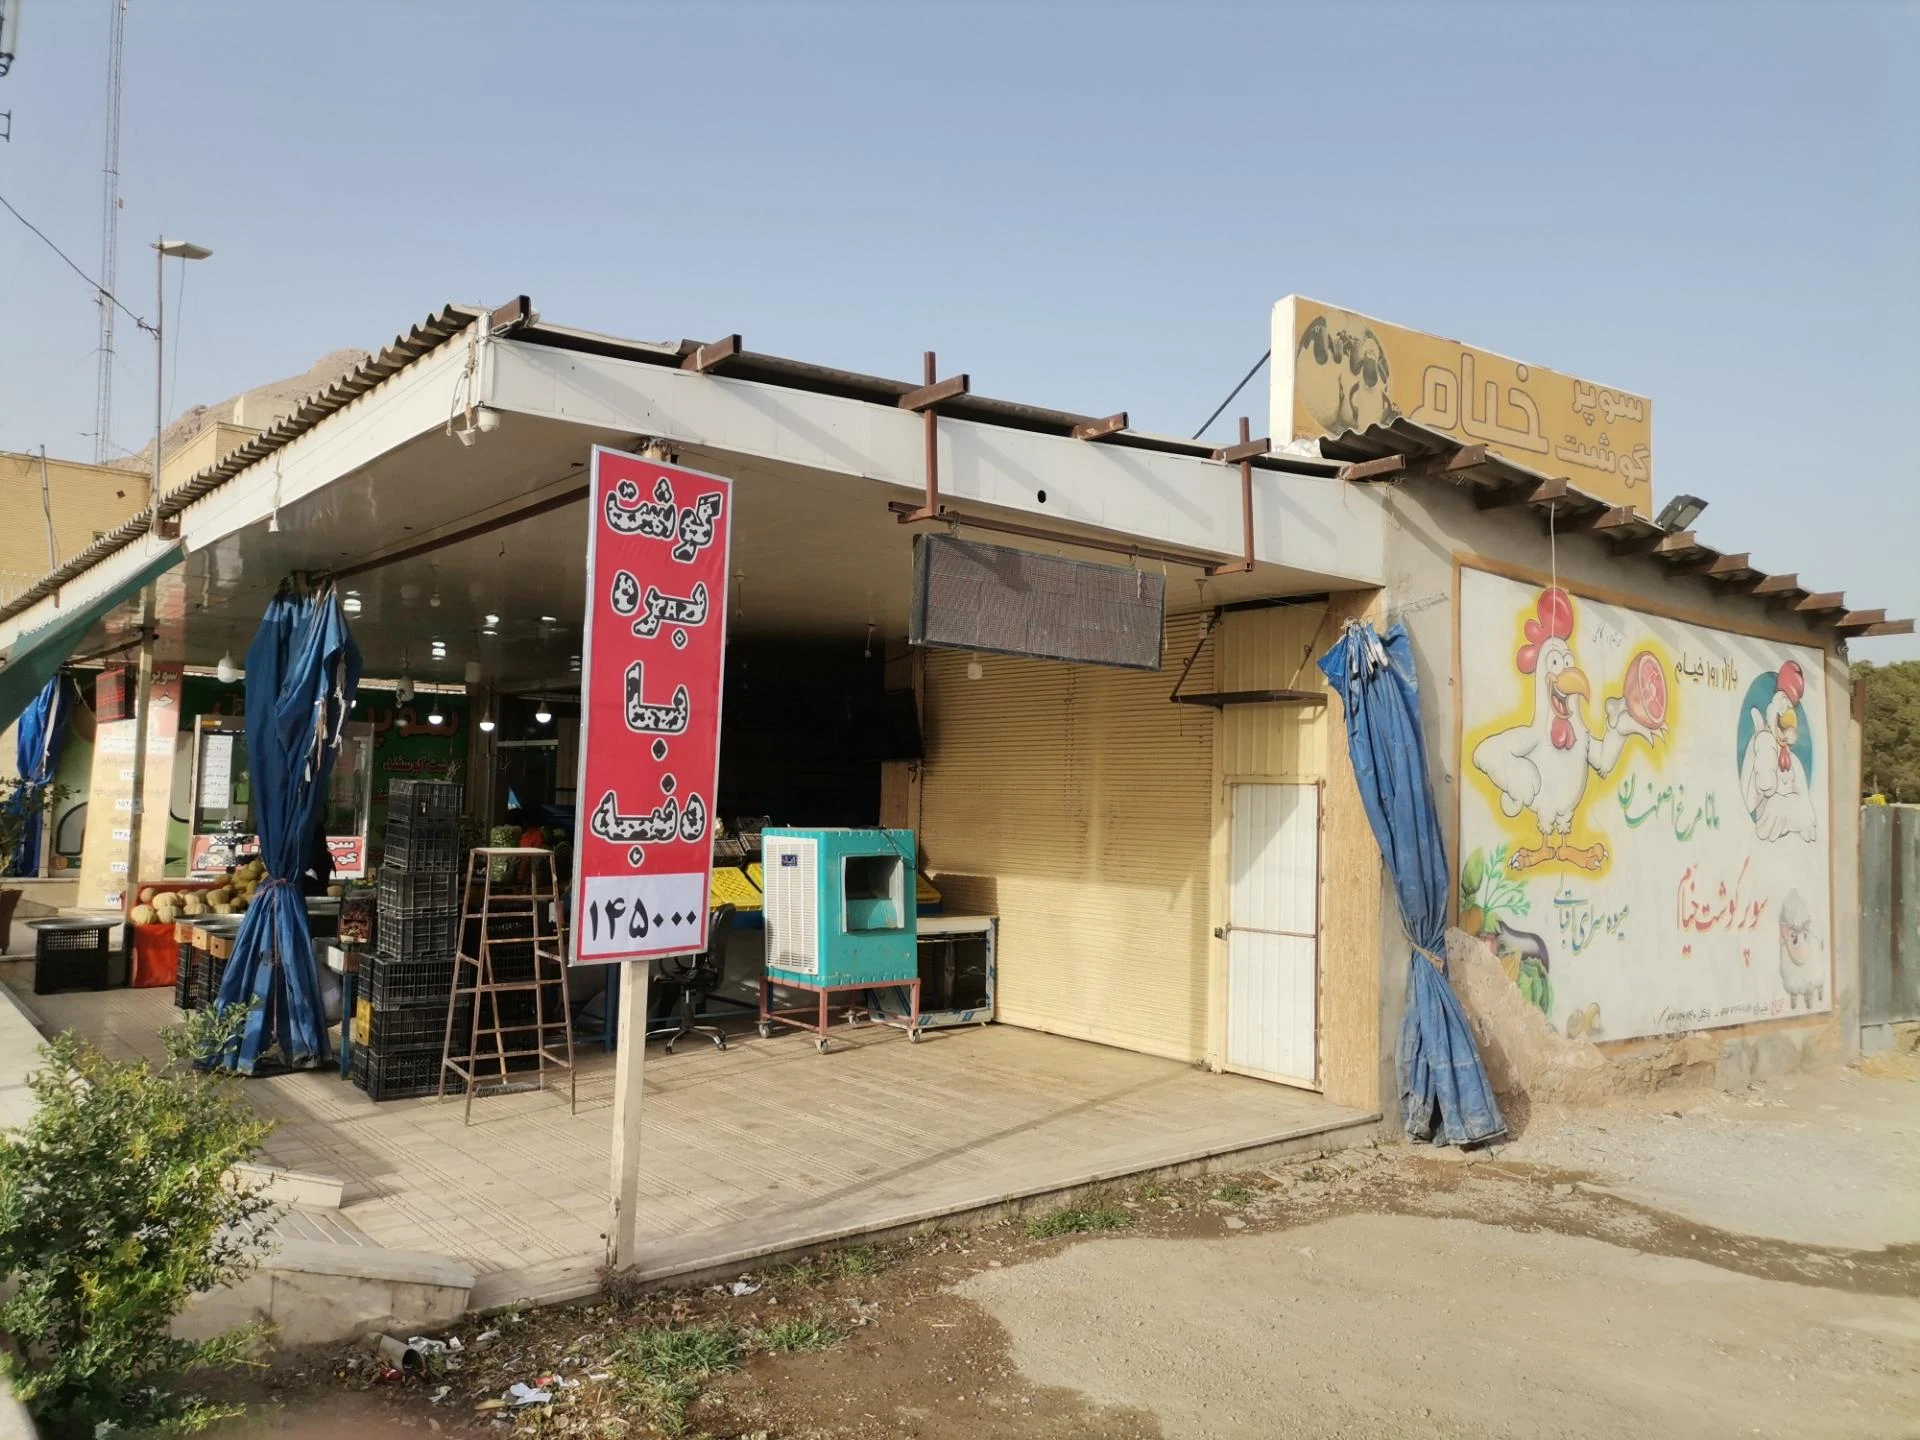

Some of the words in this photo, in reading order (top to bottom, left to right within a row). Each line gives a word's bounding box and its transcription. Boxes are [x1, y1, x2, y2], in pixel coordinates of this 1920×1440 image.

[1571, 379, 1645, 426] سوپر
[1554, 432, 1650, 489] گوشت
[604, 477, 723, 564] گوشت
[610, 569, 708, 649] بره
[1674, 650, 1704, 684] خیام
[624, 659, 690, 762] با
[590, 773, 708, 868] دنبه
[588, 894, 698, 944] ۱۴۵۰۰۰
[1676, 862, 1701, 961] خیام
[1694, 854, 1752, 934] گوشت
[1737, 896, 1768, 969] سوپر
